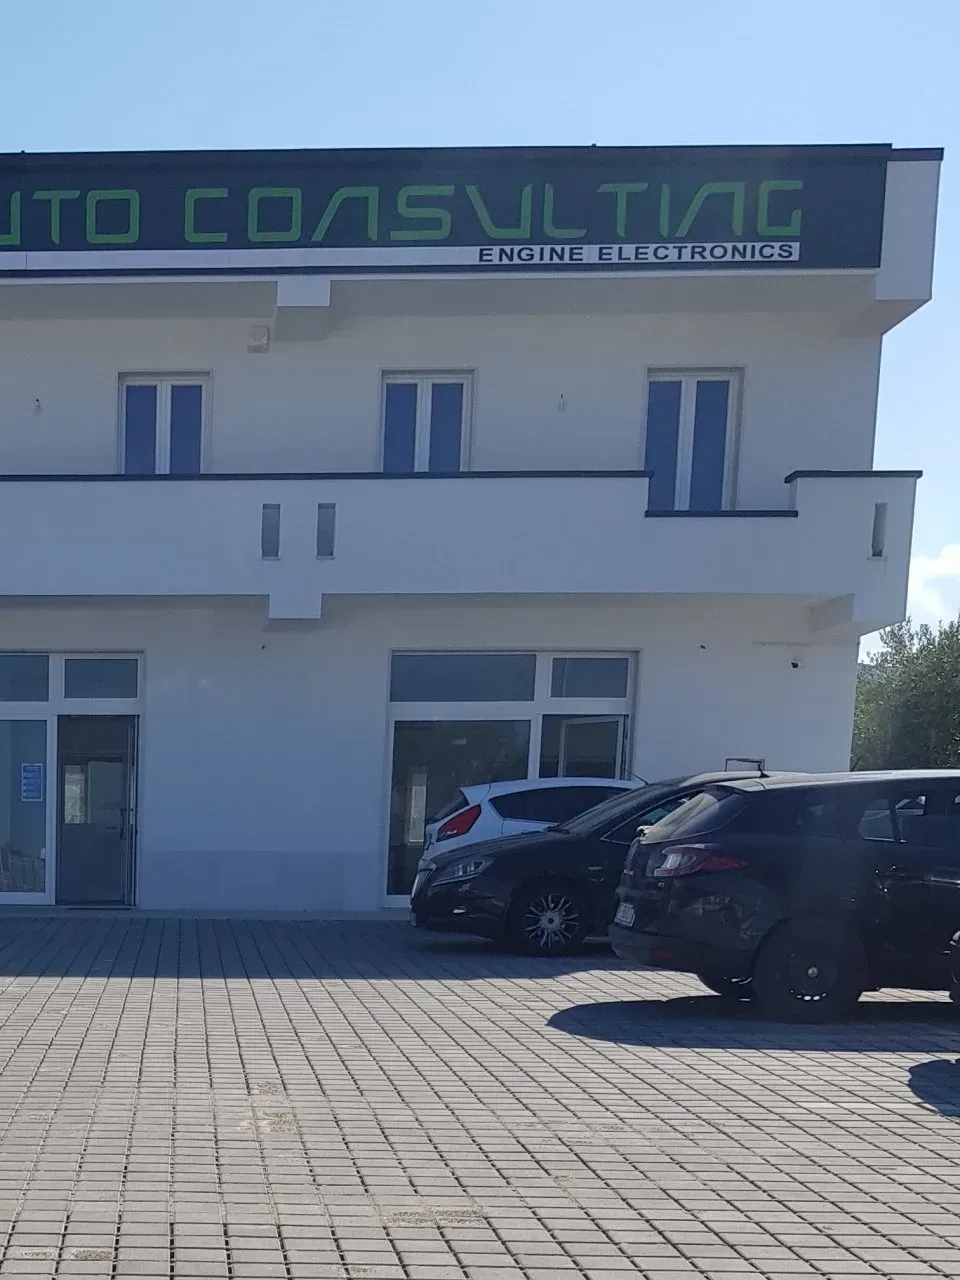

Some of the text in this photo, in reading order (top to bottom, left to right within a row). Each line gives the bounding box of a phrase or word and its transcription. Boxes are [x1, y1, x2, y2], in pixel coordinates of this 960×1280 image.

[183, 179, 804, 244] CONSULTING
[478, 241, 795, 263] ENGINE ELECTRONICS
